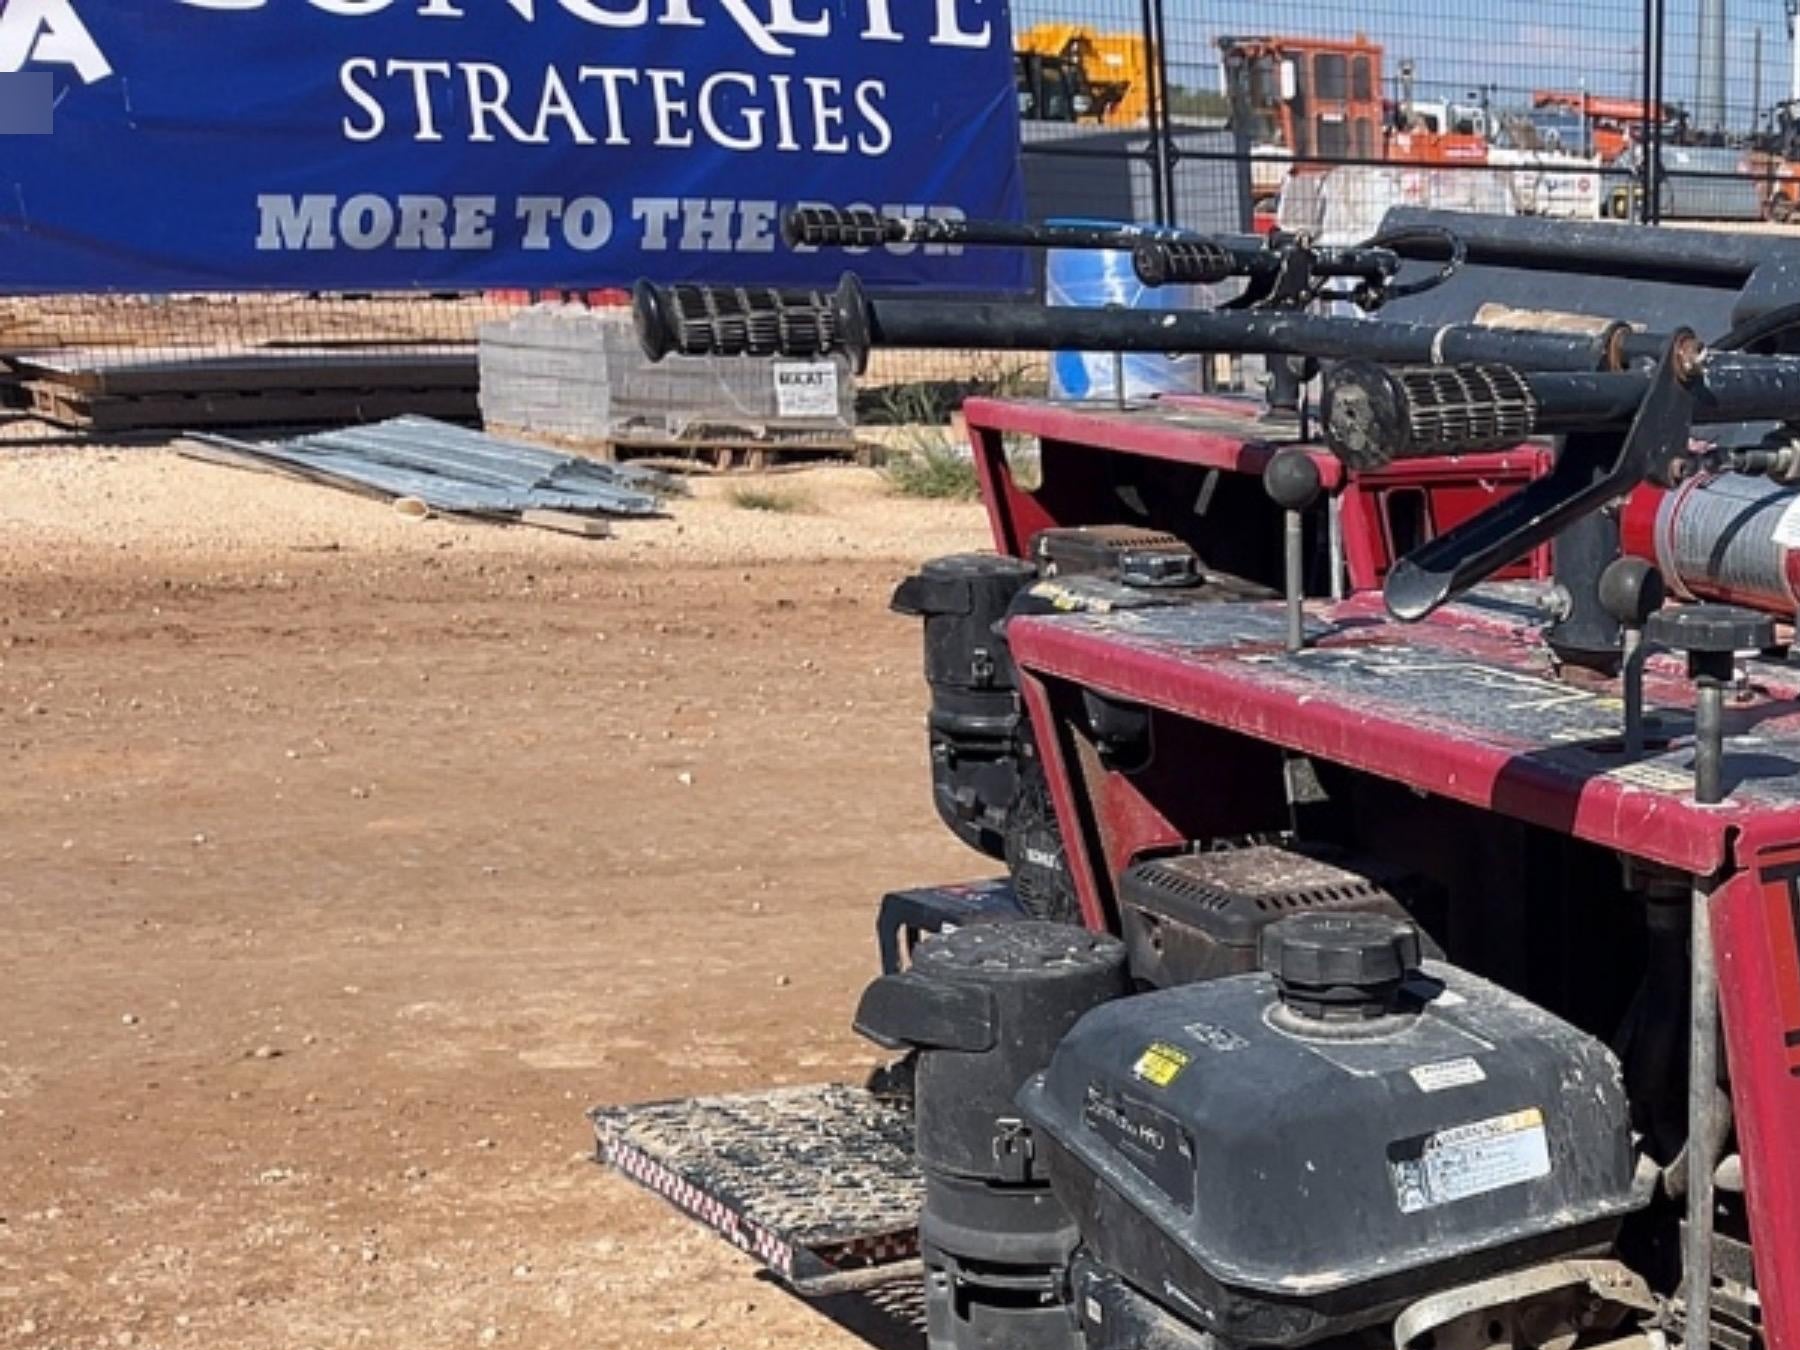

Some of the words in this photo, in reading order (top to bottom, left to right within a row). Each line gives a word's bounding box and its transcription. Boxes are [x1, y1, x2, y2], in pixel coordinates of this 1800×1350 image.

[337, 57, 893, 156] STRATEGIES
[255, 193, 497, 250] MORE
[517, 197, 612, 250] TO
[632, 199, 776, 251] THE
